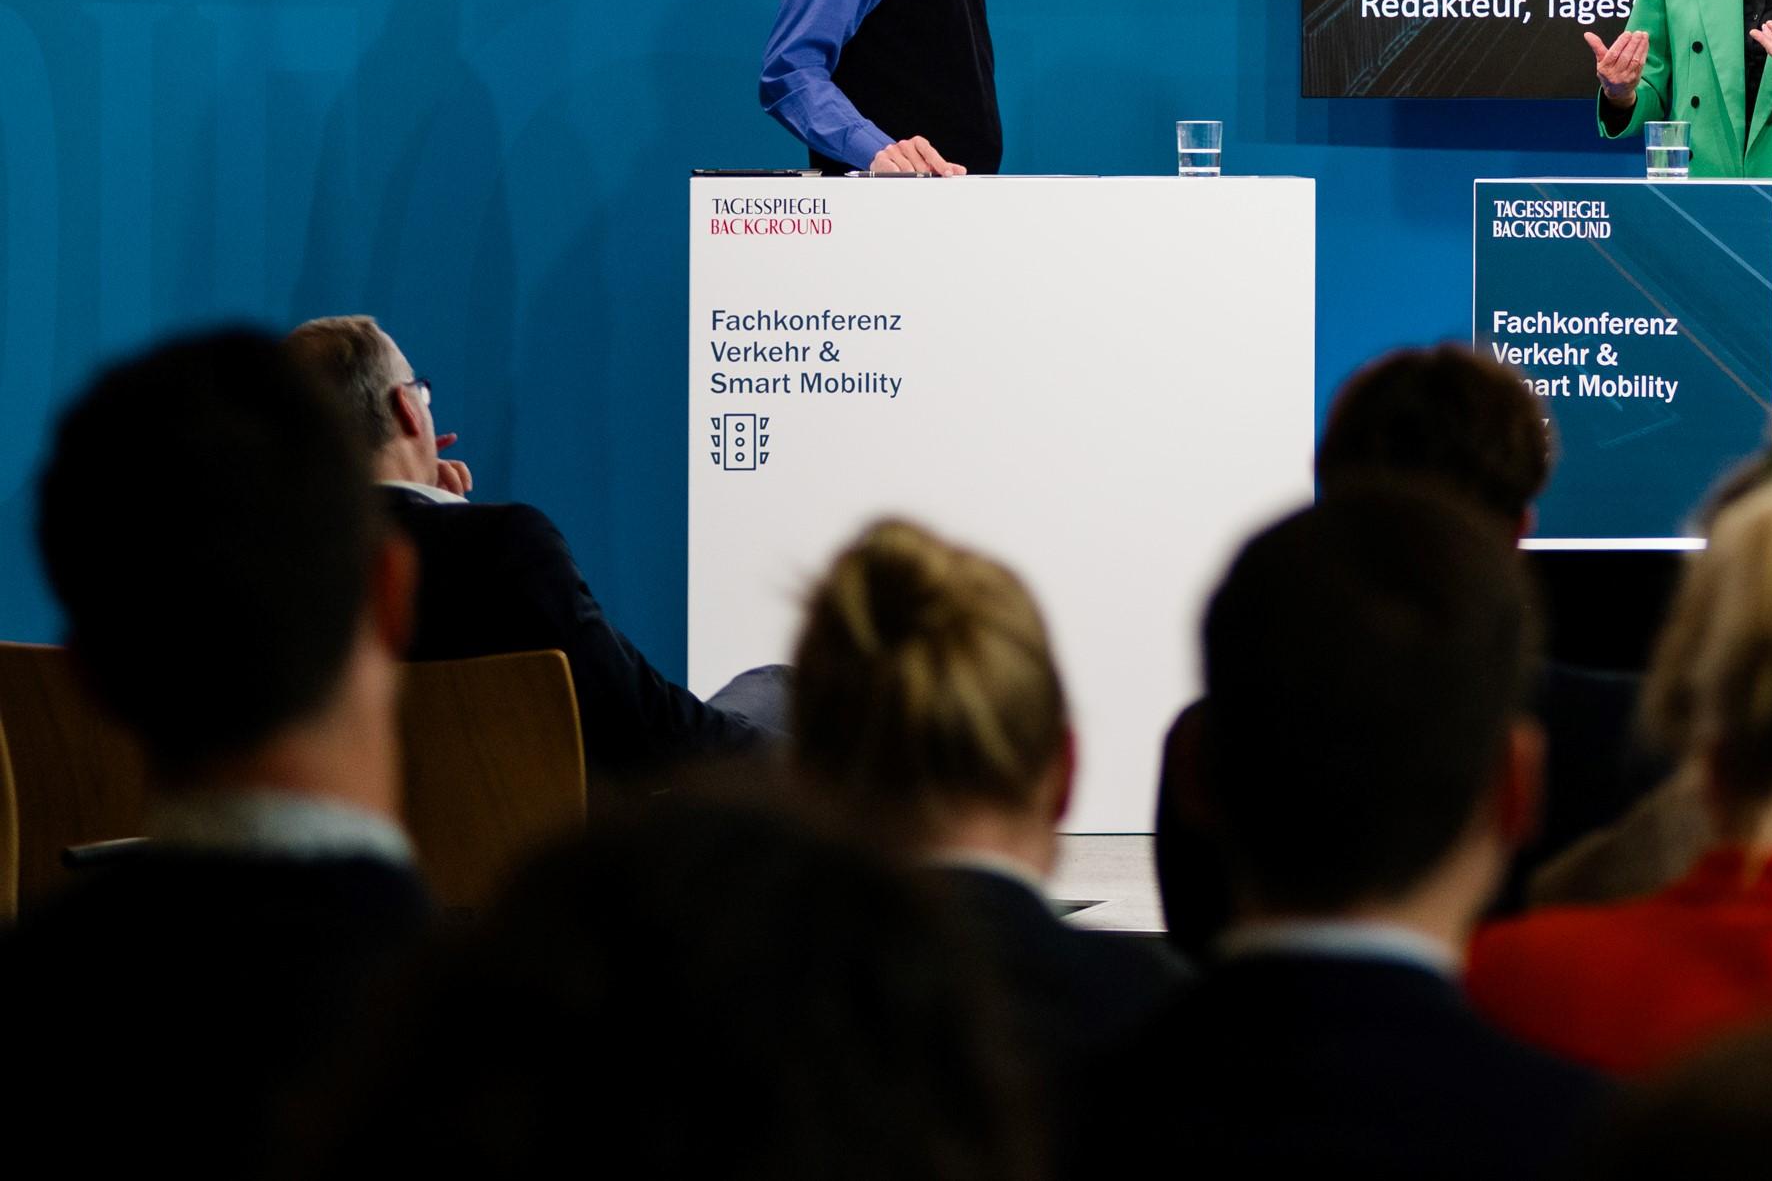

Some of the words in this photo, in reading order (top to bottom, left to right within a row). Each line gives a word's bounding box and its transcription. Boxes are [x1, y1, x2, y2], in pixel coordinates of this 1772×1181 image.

[711, 198, 831, 215] TAGESSPIEGEL
[1493, 200, 1610, 219] TAGESSPIEGEL
[710, 218, 832, 235] BACKGROUND
[1492, 220, 1611, 239] BACKGROUND
[711, 309, 902, 332] Fachkonferenz
[1493, 310, 1678, 336] Fachkonferenz
[710, 340, 811, 363] Verkehr
[818, 340, 840, 363] &
[1492, 342, 1590, 366] Verkehr
[1596, 343, 1618, 366] &
[710, 372, 791, 394] Smart
[800, 372, 903, 399] Mobility
[1578, 374, 1679, 404] Mobility
